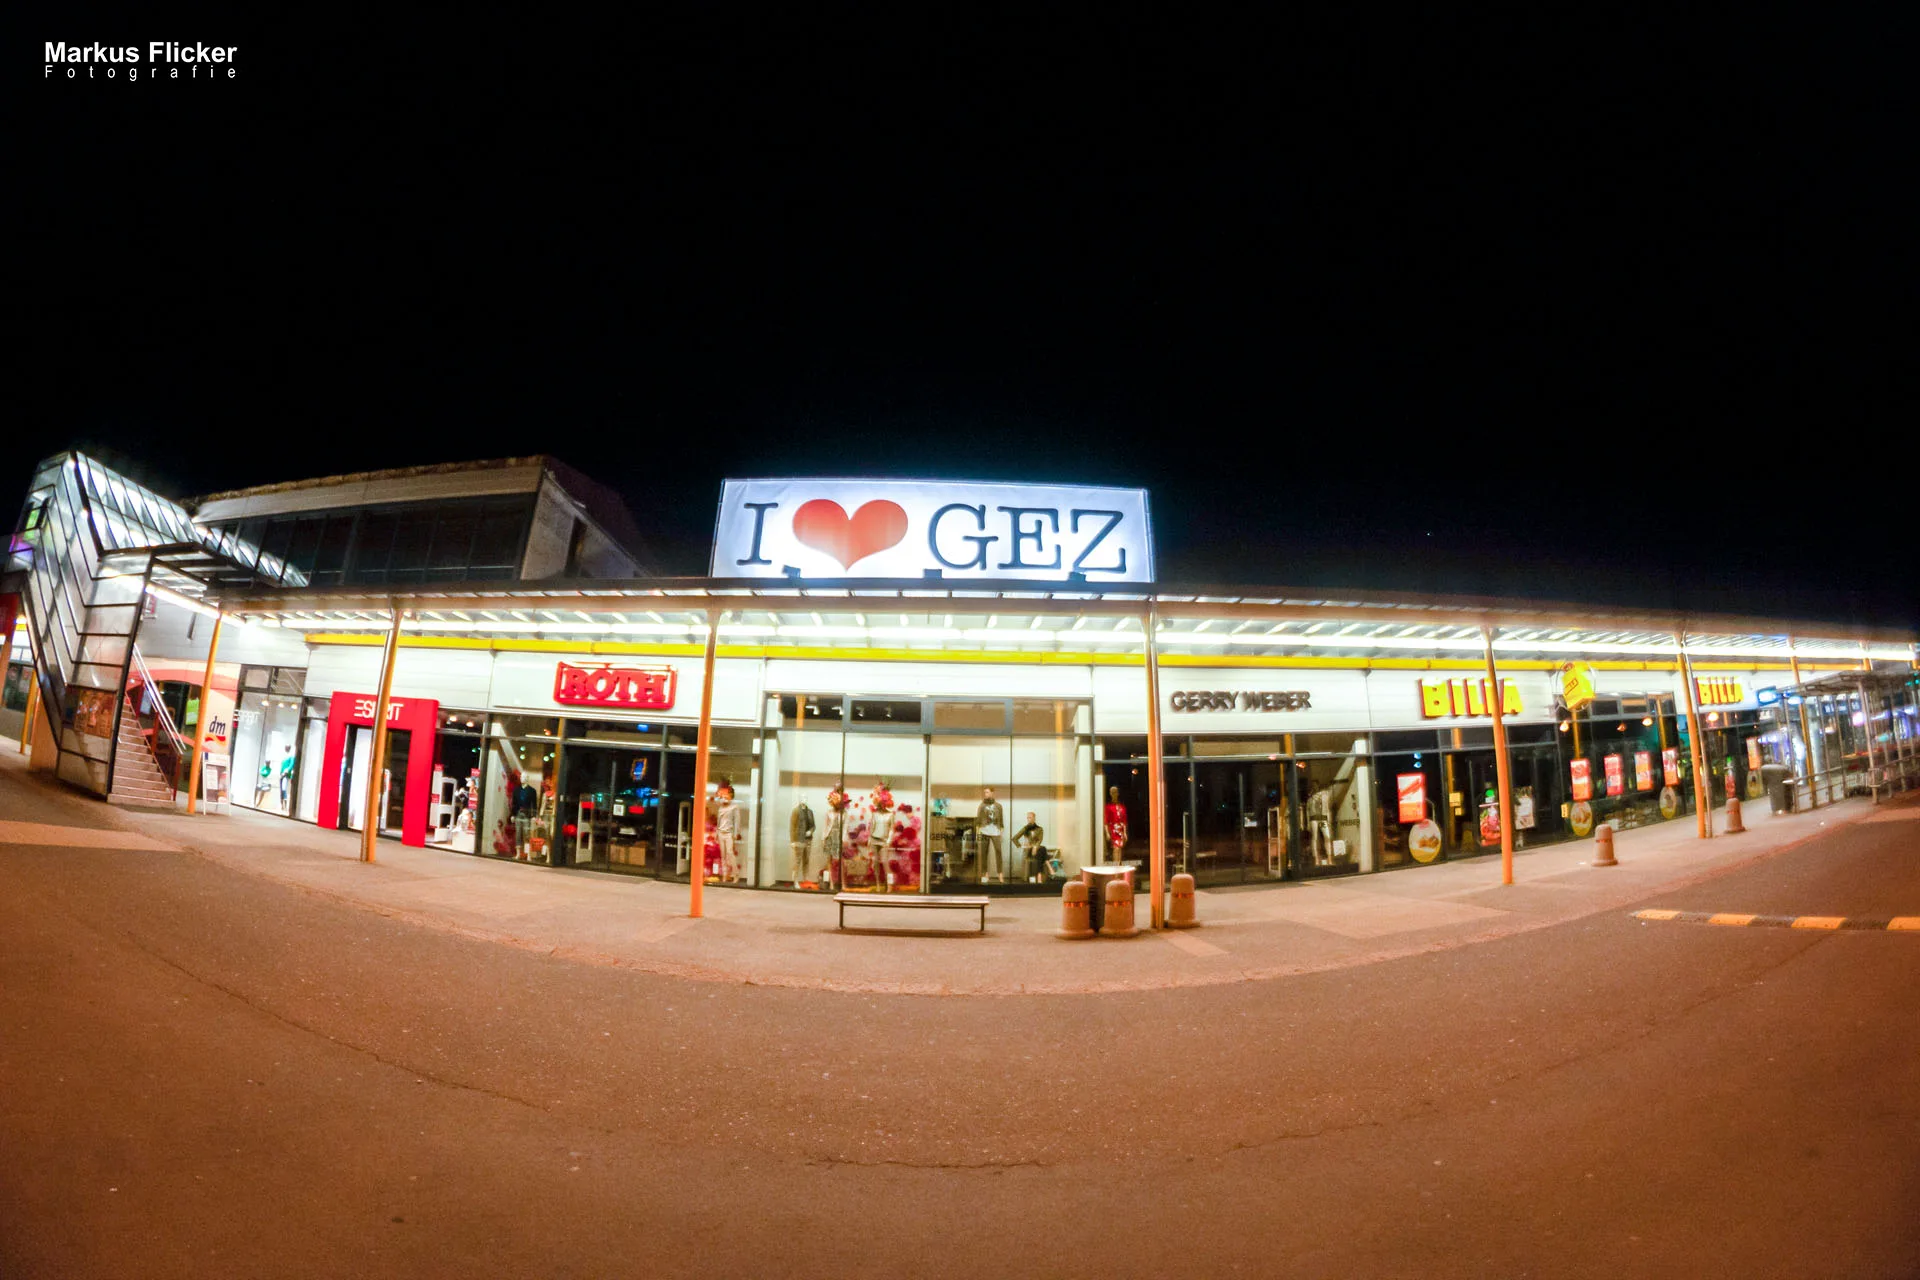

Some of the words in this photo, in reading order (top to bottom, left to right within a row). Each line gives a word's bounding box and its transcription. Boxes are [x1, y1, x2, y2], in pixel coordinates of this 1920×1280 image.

[735, 501, 779, 567] I
[926, 502, 1128, 575] GEZ
[1170, 690, 1239, 713] GERRY
[1241, 690, 1312, 713] WEBER
[1693, 676, 1744, 706] BILLA
[209, 715, 226, 735] dm
